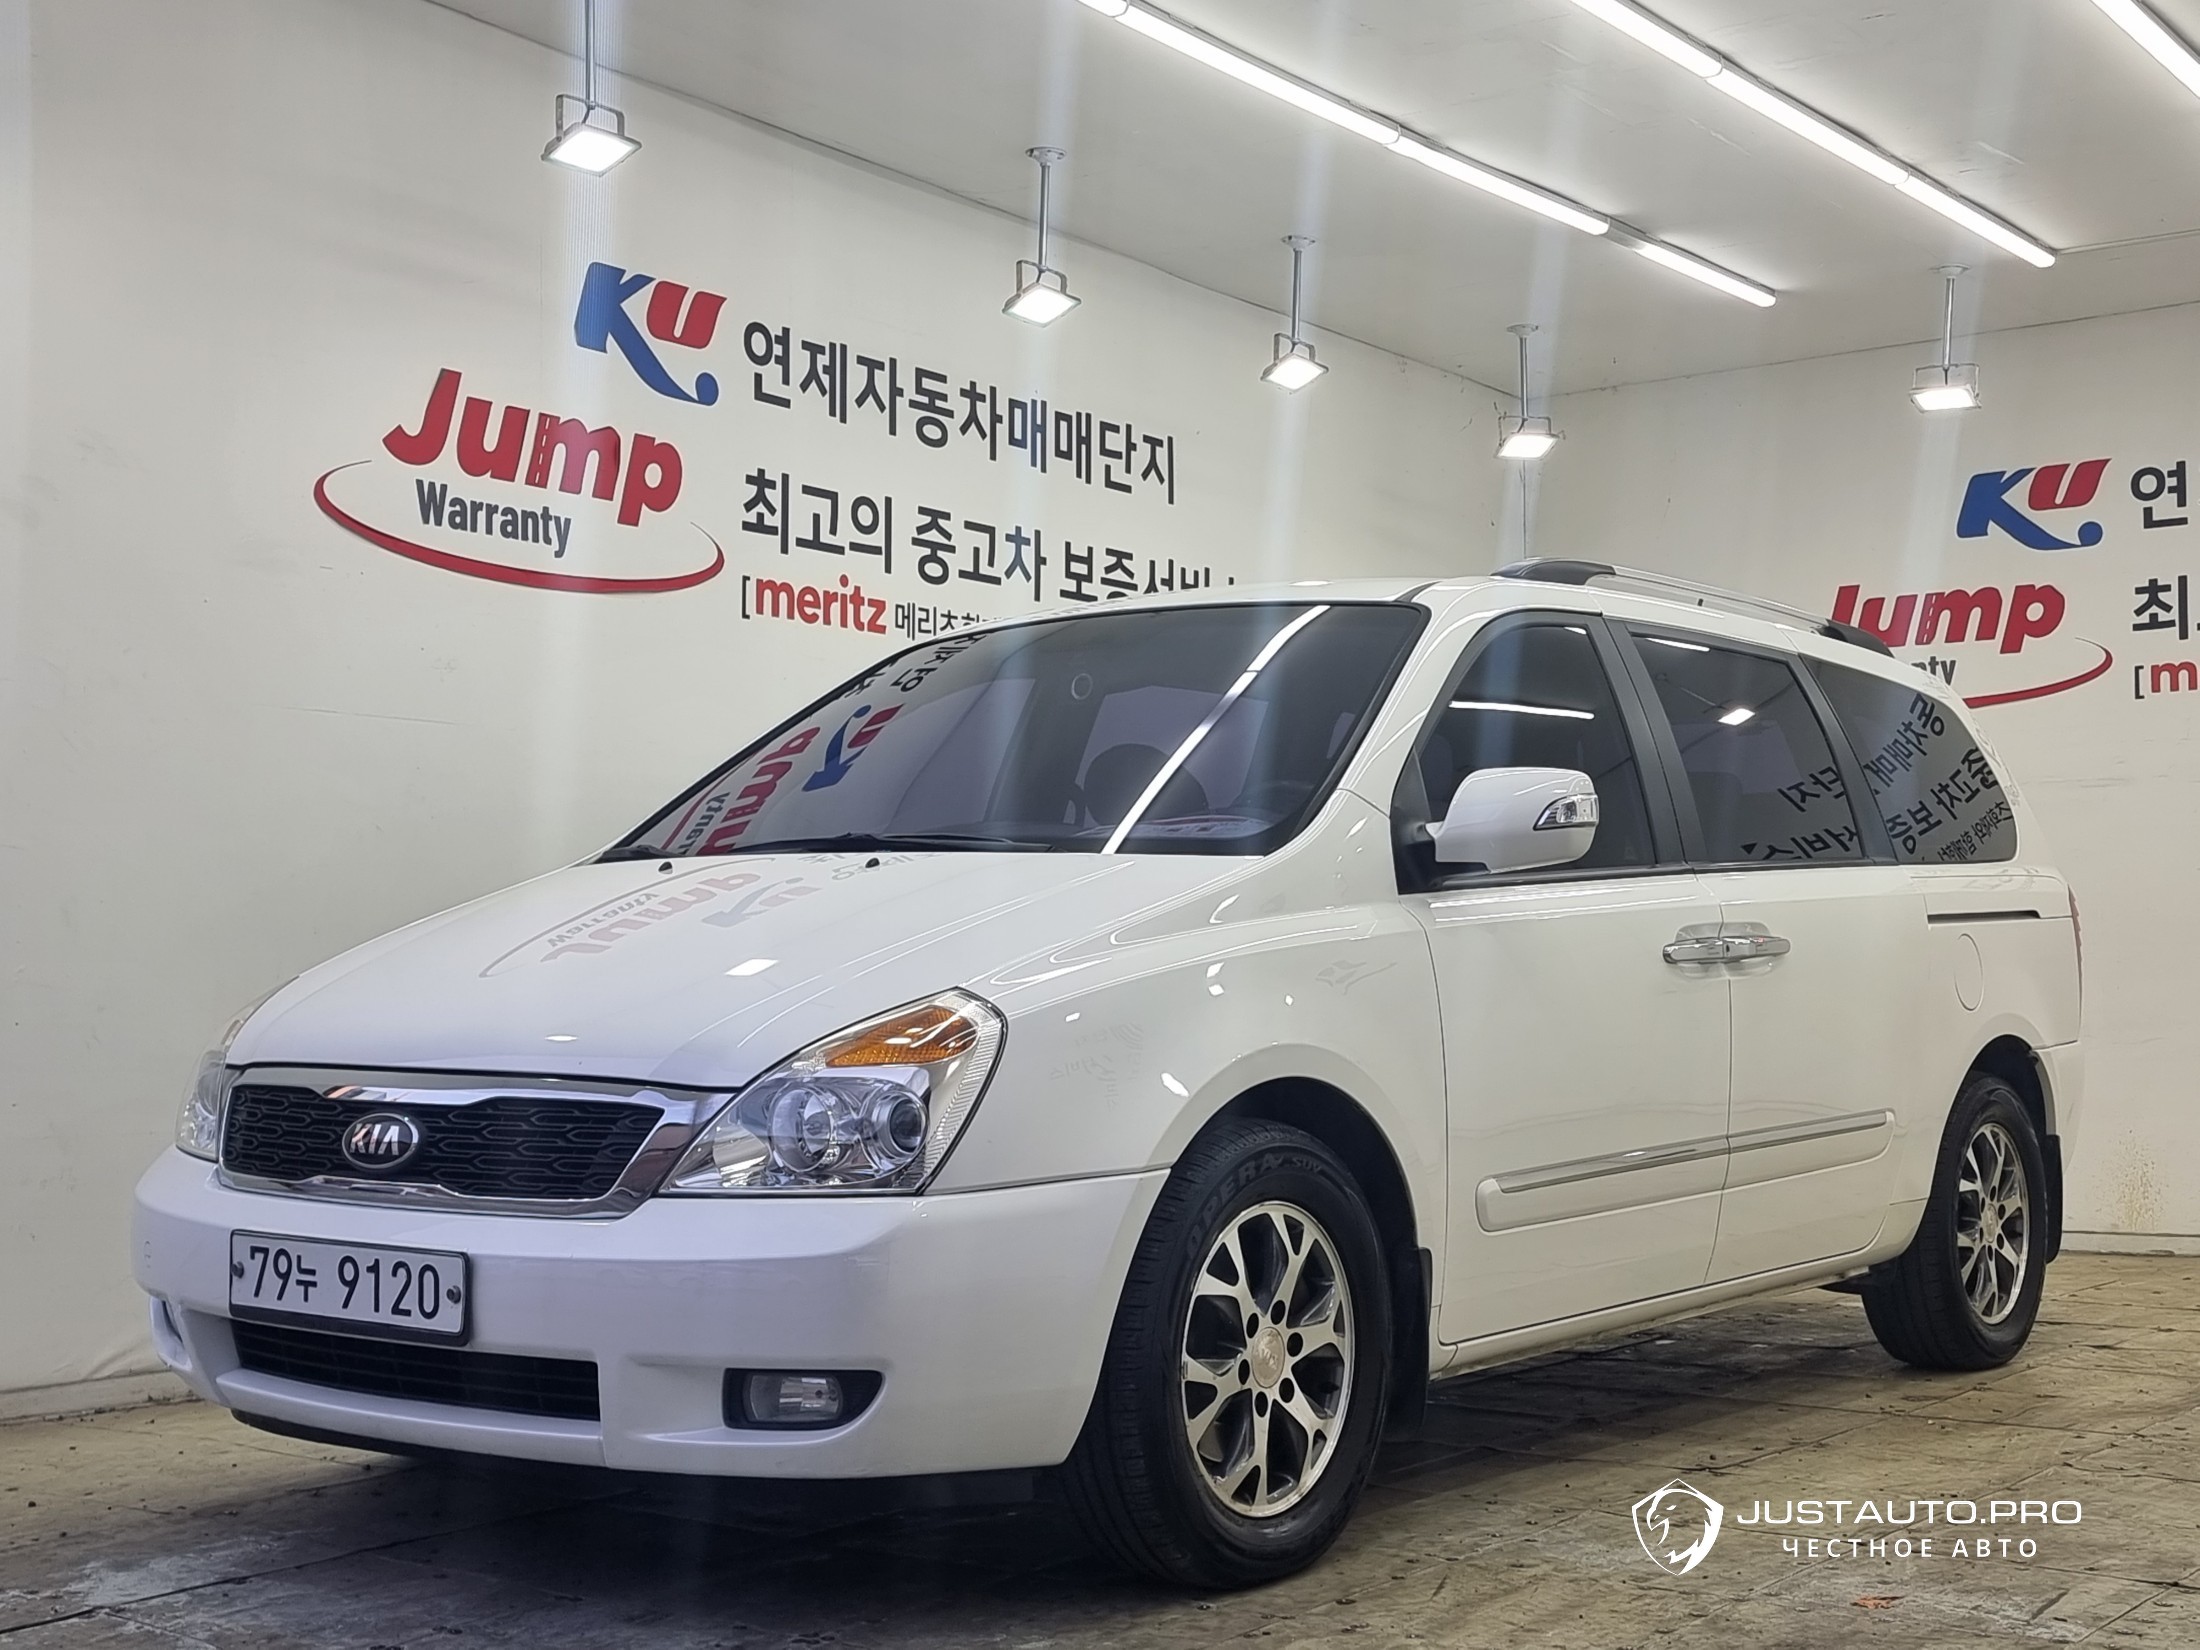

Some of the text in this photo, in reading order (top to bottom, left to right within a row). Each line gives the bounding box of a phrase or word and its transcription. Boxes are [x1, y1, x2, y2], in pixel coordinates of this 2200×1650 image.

[382, 368, 682, 527] Jump
[743, 321, 1175, 505] 연제자동차매매단지
[415, 478, 572, 558] Warranty
[741, 467, 1234, 603] 최고의 중고차 보증서
[894, 601, 1000, 641] 메리츠
[2132, 575, 2200, 641] 최
[349, 1123, 400, 1156] KIA
[249, 1245, 441, 1321] 79누 9120
